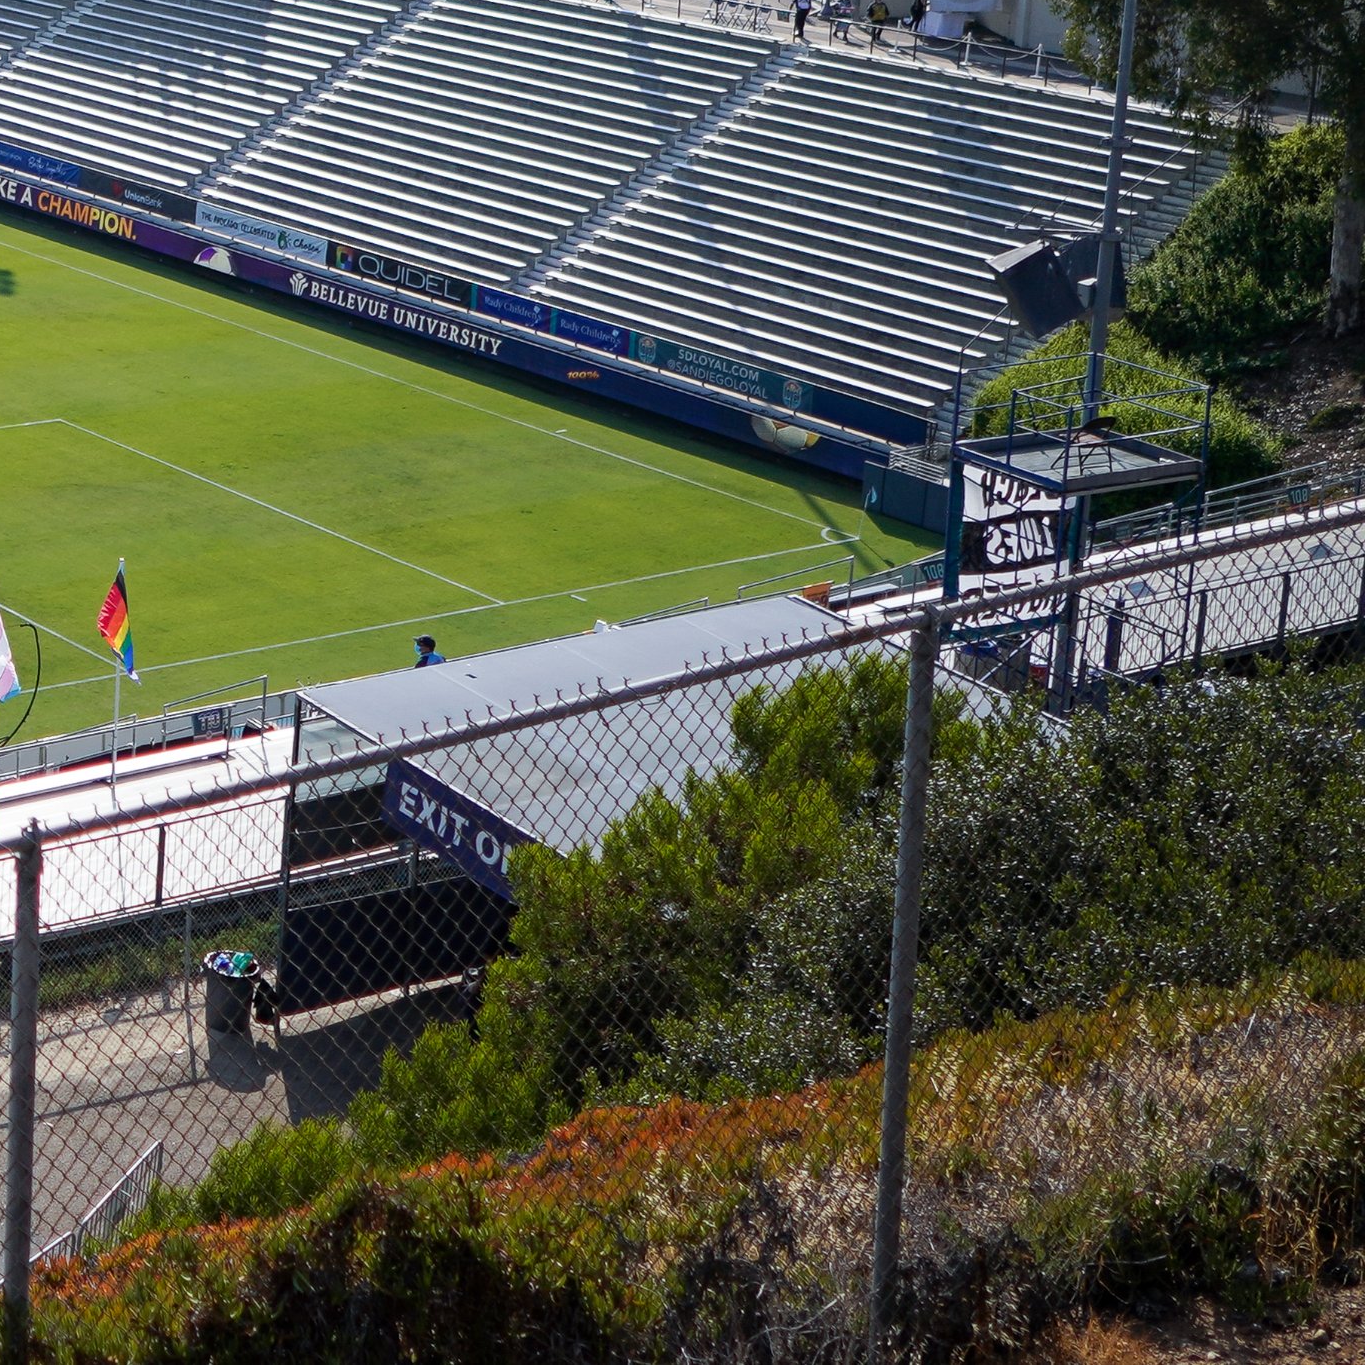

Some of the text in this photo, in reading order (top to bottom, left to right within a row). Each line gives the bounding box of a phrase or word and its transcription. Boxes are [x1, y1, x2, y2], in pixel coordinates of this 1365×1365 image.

[124, 188, 164, 209] UnionBank
[20, 186, 33, 207] A
[37, 191, 137, 241] CHAMPION.
[201, 211, 213, 220] THE
[292, 238, 322, 254] Chosen
[358, 254, 462, 302] QUIDEL
[484, 295, 503, 312] Rady
[309, 280, 503, 357] BELLEVUE UNIVERSITY
[560, 317, 581, 336] Rady
[566, 369, 601, 381] 100%
[677, 347, 760, 383] SDLOYAL.COM
[667, 359, 769, 400] @SANDIEGOLOYAL
[1290, 488, 1308, 504] 108
[399, 782, 469, 847] EXIT
